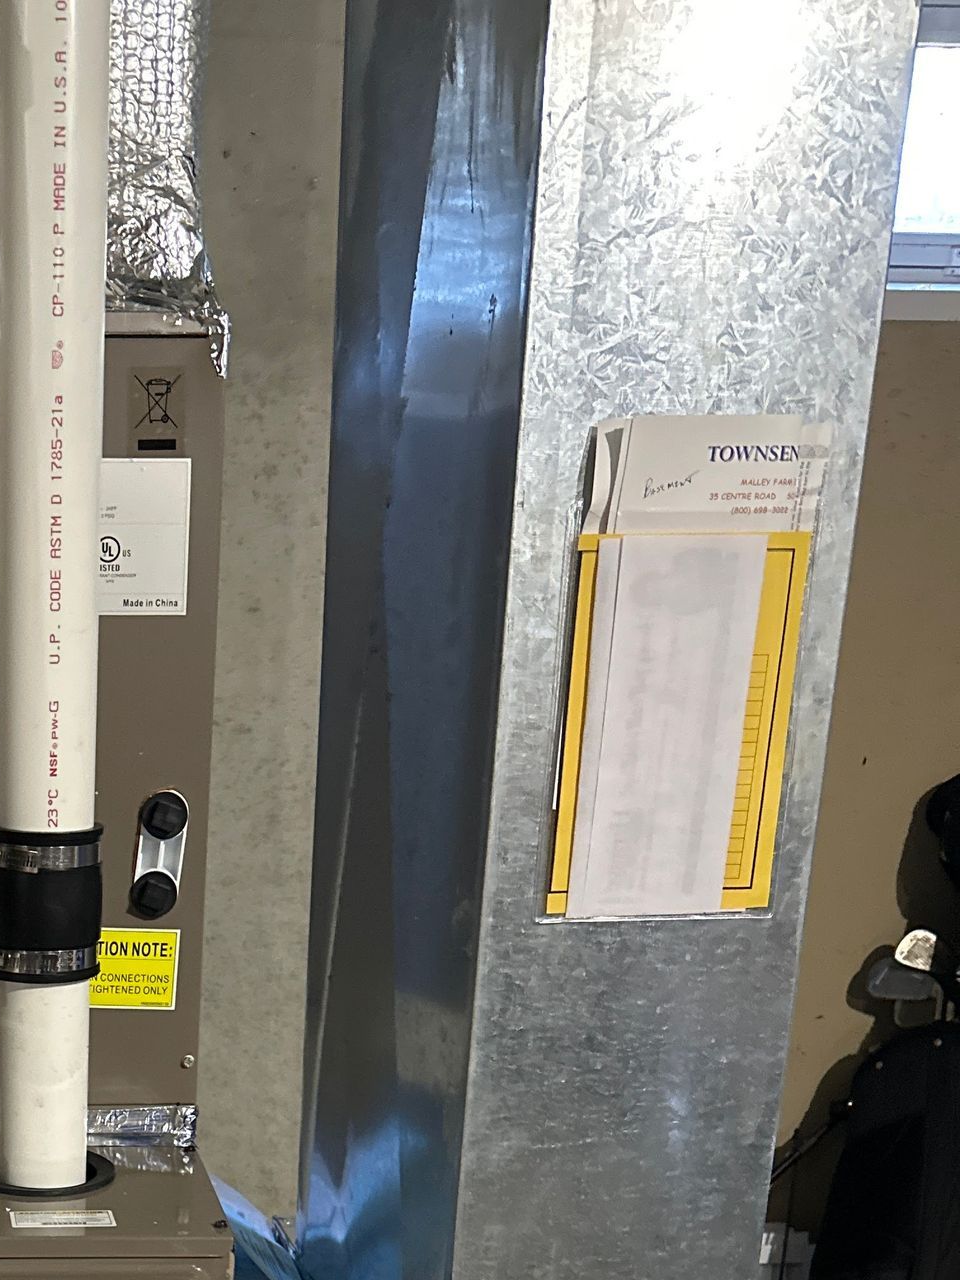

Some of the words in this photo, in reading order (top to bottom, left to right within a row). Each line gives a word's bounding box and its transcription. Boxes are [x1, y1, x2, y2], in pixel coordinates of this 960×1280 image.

[54, 38, 68, 114] U.S.A.
[54, 126, 67, 148] IN
[53, 162, 66, 212] MADE
[52, 222, 65, 235] P
[51, 393, 63, 481] 1785-21a
[740, 478, 771, 487] MALLEY
[51, 493, 62, 505] D
[709, 492, 719, 501] 35
[721, 491, 753, 501] CENTRE
[754, 491, 777, 501] ROAD
[730, 505, 752, 516] (800)
[51, 515, 62, 559] ASTM
[122, 549, 132, 558] US
[50, 569, 62, 612] CODE
[122, 598, 144, 607] Made
[145, 598, 153, 607] in
[155, 598, 178, 607] China
[131, 942, 173, 958] NOTE:
[100, 973, 170, 984] CONNECTIONS
[143, 985, 168, 996] ONLY
